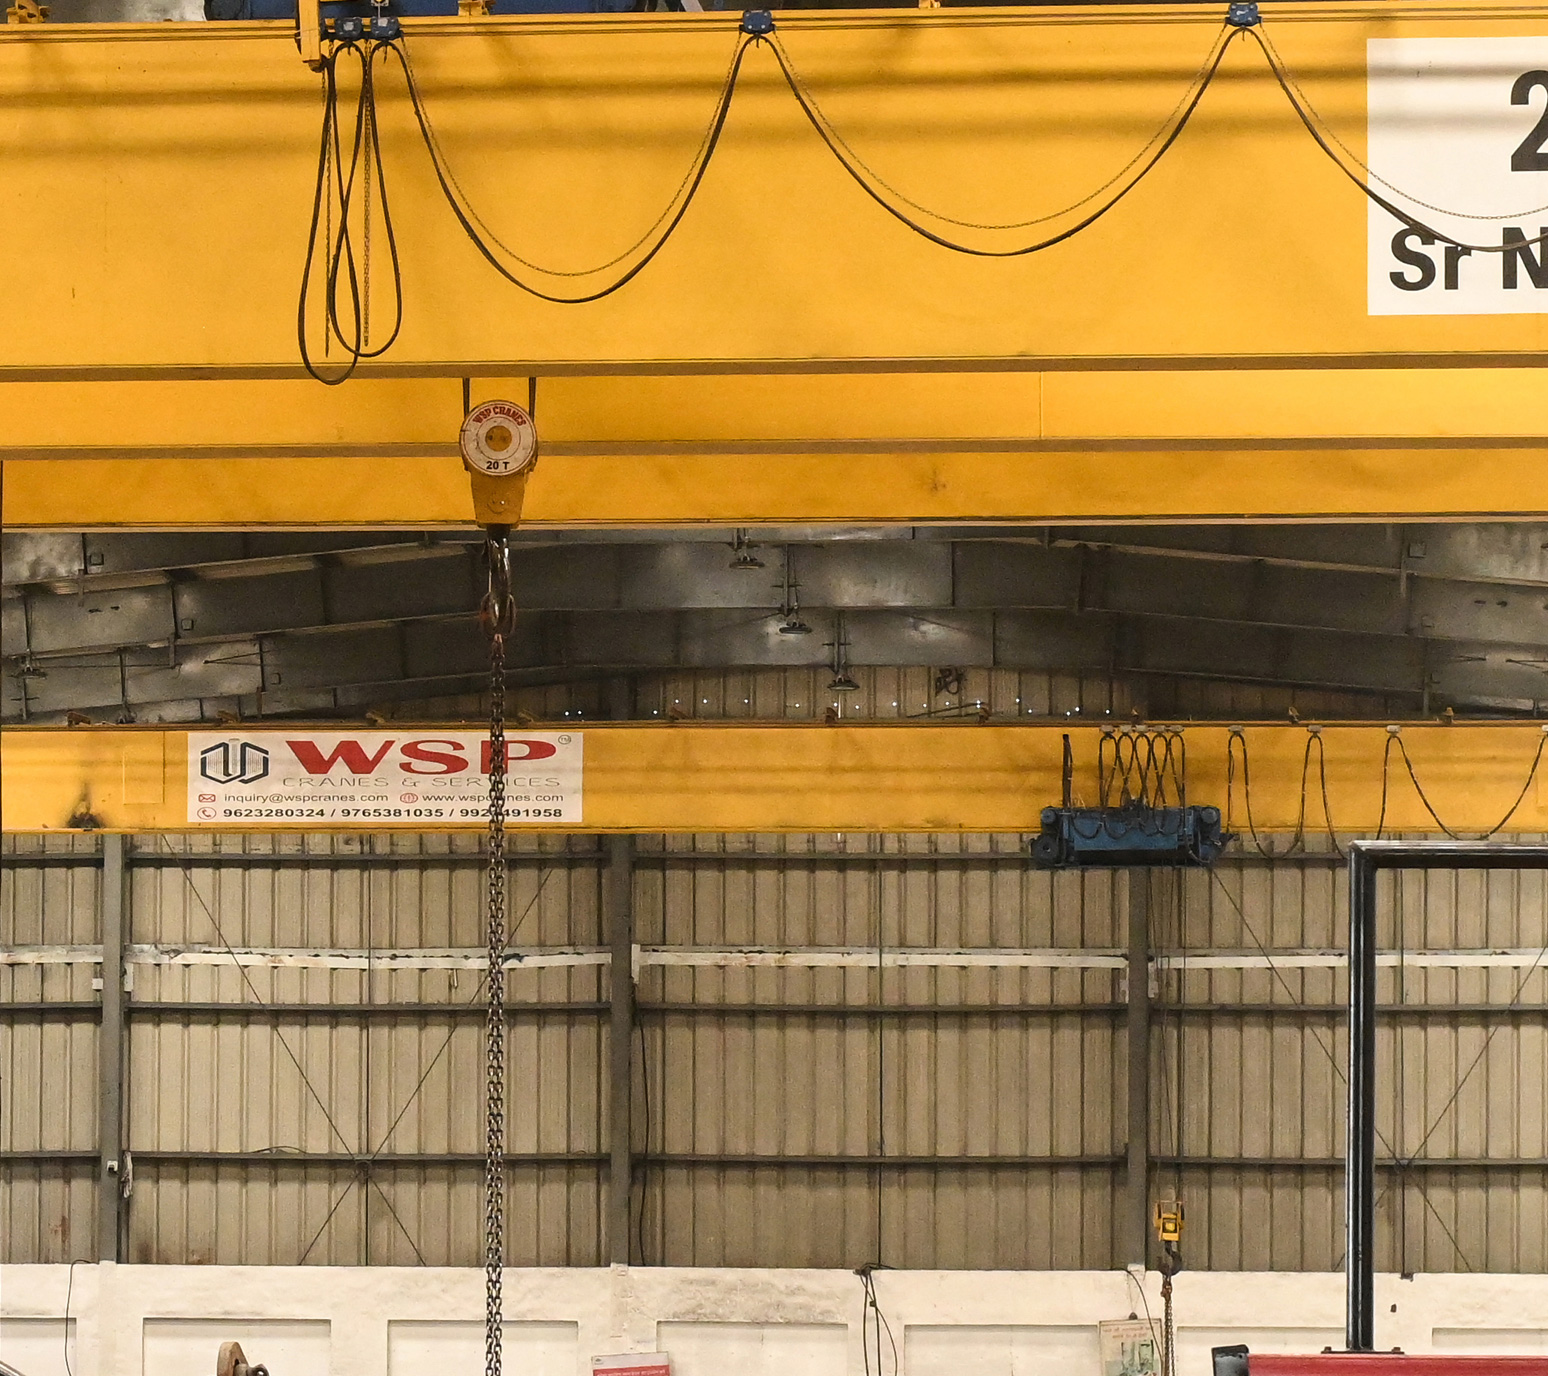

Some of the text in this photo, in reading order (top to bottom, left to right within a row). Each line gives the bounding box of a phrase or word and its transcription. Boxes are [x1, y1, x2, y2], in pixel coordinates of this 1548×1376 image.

[1389, 228, 1472, 291] Sr
[472, 405, 527, 426] WSP CRANES
[486, 460, 510, 470] 20 T
[285, 739, 556, 774] WSP
[283, 777, 561, 787] CRANES & SERICES
[224, 793, 389, 804] inquiry@wspcranes.com
[223, 808, 325, 818] 9623280324
[341, 808, 444, 818] 9765381035
[460, 808, 563, 818] 992491958
